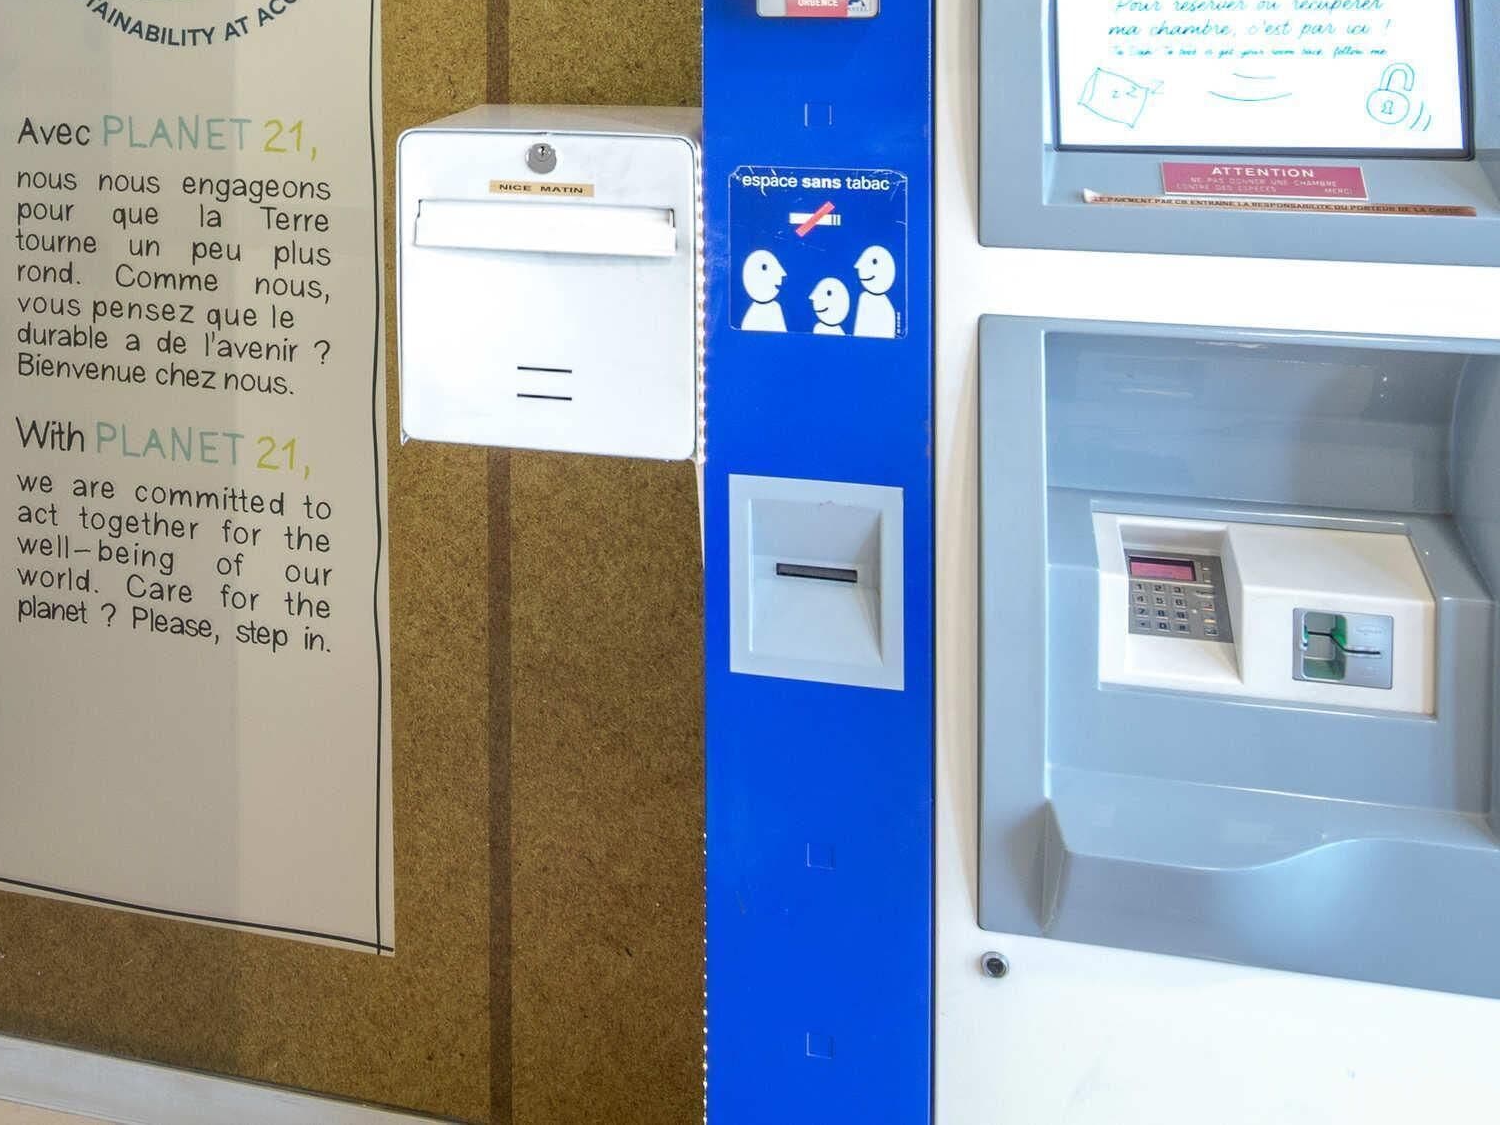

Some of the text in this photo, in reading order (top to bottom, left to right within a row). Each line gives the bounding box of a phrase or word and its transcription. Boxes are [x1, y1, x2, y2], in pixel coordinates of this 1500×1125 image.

[1257, 0, 1278, 11] ou
[225, 16, 250, 40] AT
[1108, 25, 1139, 35] ma
[1248, 20, 1291, 35] c'est
[1298, 23, 1336, 39] par
[18, 115, 317, 161] Avec PLANET 21,
[17, 171, 331, 203] nous nous engageons
[499, 184, 583, 194] NICE MATIN
[742, 175, 890, 192] espace sans tabac
[1211, 166, 1315, 178] ATTENTION
[17, 202, 329, 232] pour que la Terre
[16, 229, 331, 269] tourne un peu plus
[18, 261, 330, 305] rond. Comme nous,
[18, 297, 294, 331] vous pensez que le
[18, 322, 330, 364] durable a de l'avenir ?
[18, 353, 293, 394] Bienvenue chez nous.
[16, 417, 310, 479] With PLANET 21,
[17, 475, 331, 520] we are committed to
[18, 503, 330, 552] act together for the
[18, 535, 332, 586] well-being of our
[18, 567, 330, 619] world. Care for the
[18, 596, 330, 653] planet ? Please, step in.
